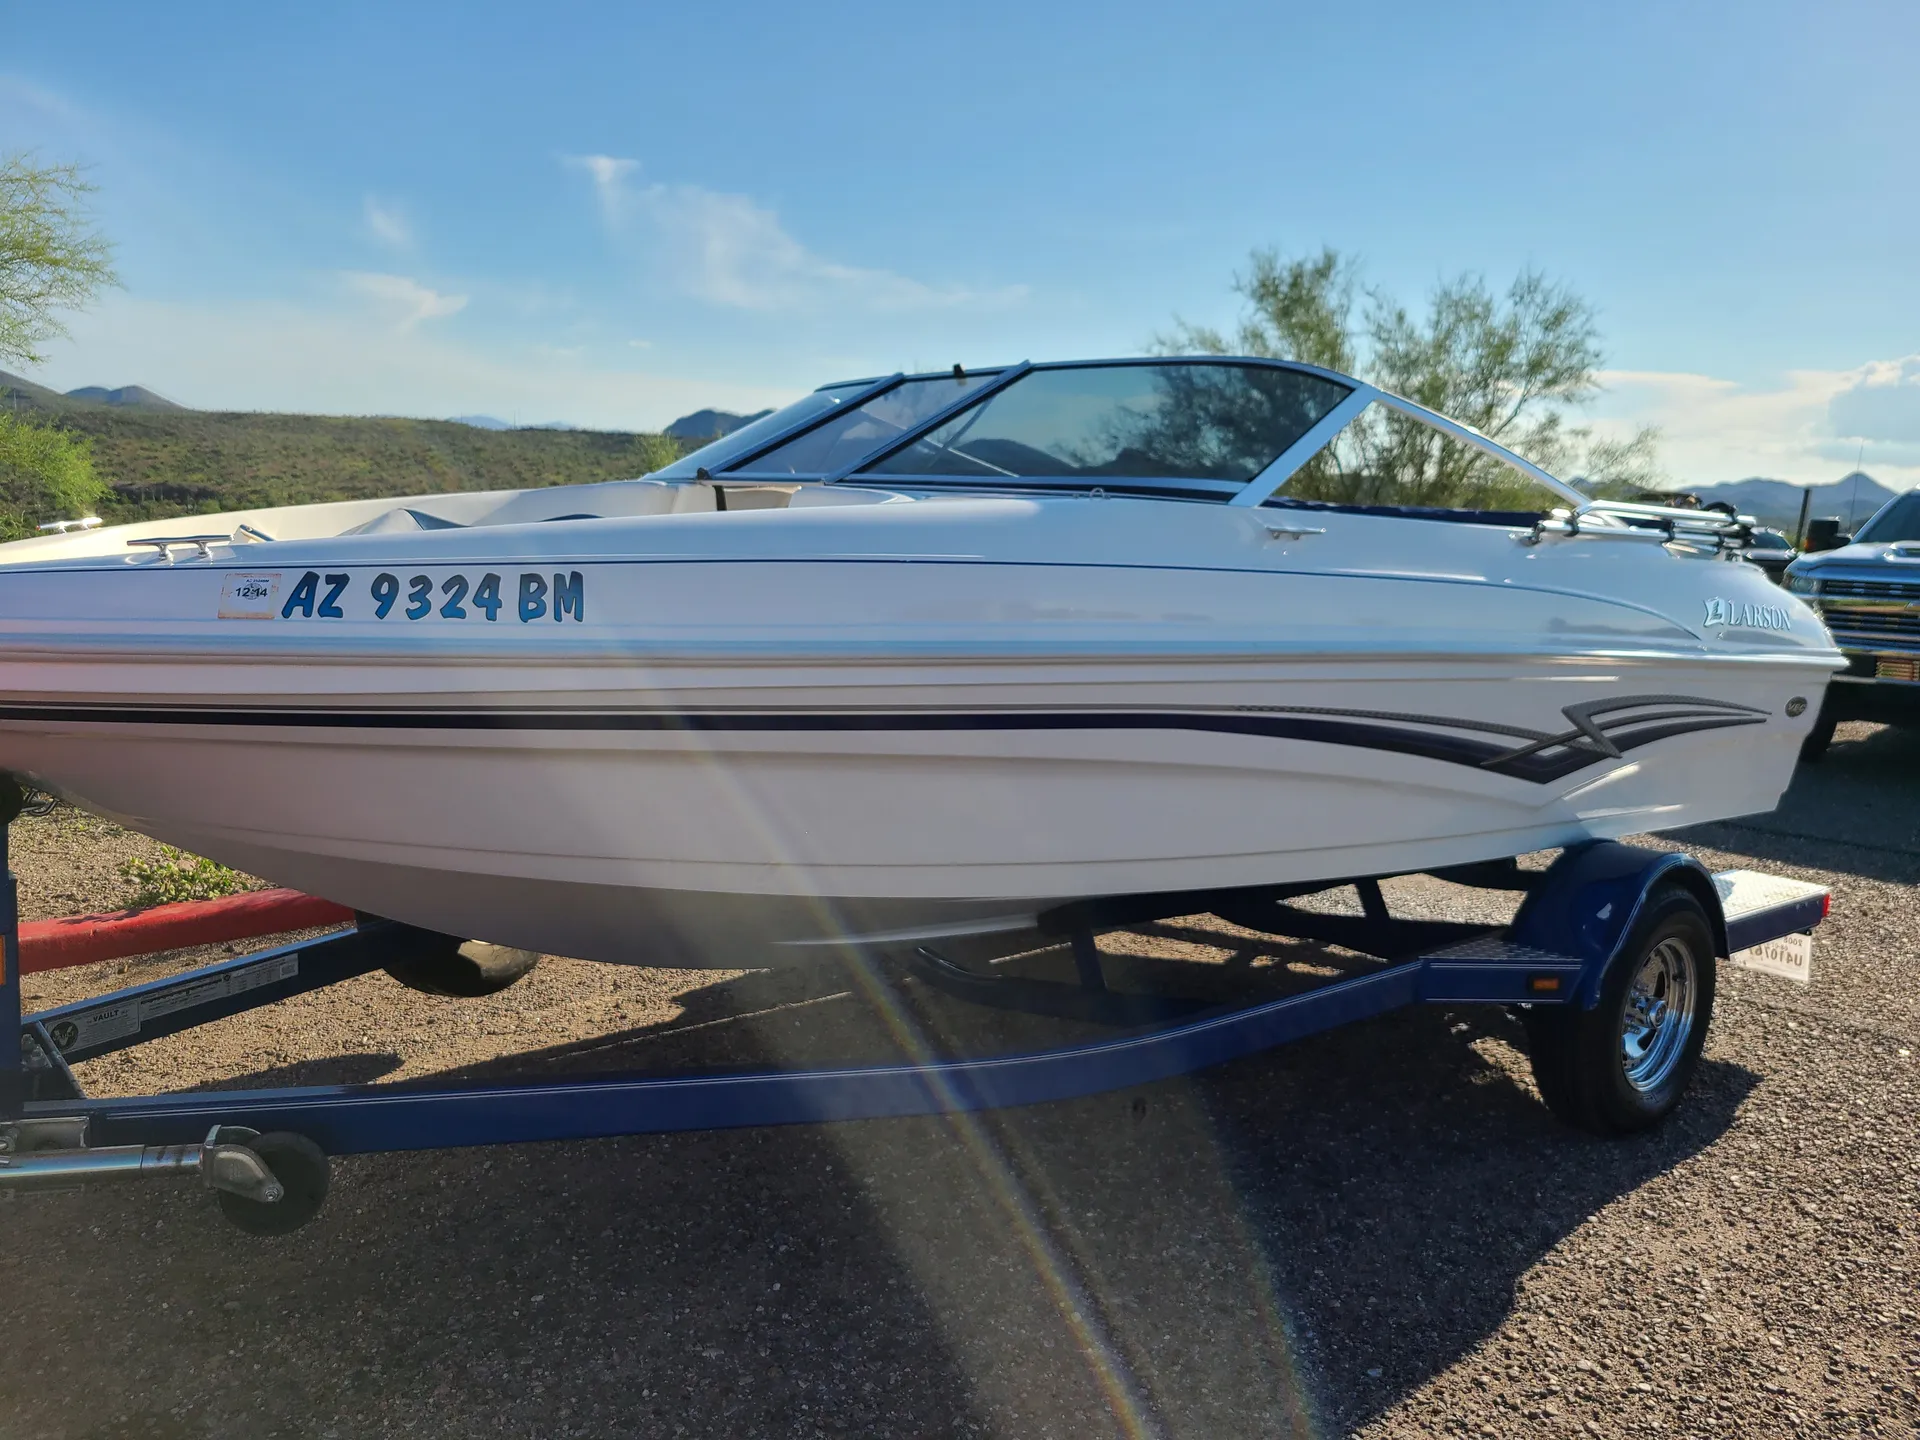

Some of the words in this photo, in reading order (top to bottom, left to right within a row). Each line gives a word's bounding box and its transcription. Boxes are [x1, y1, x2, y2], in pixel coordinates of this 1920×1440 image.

[281, 571, 350, 618] AZ
[370, 572, 502, 621] 9324
[518, 571, 584, 623] BM
[1728, 600, 1791, 631] LARSON
[93, 1009, 120, 1022] VAULT
